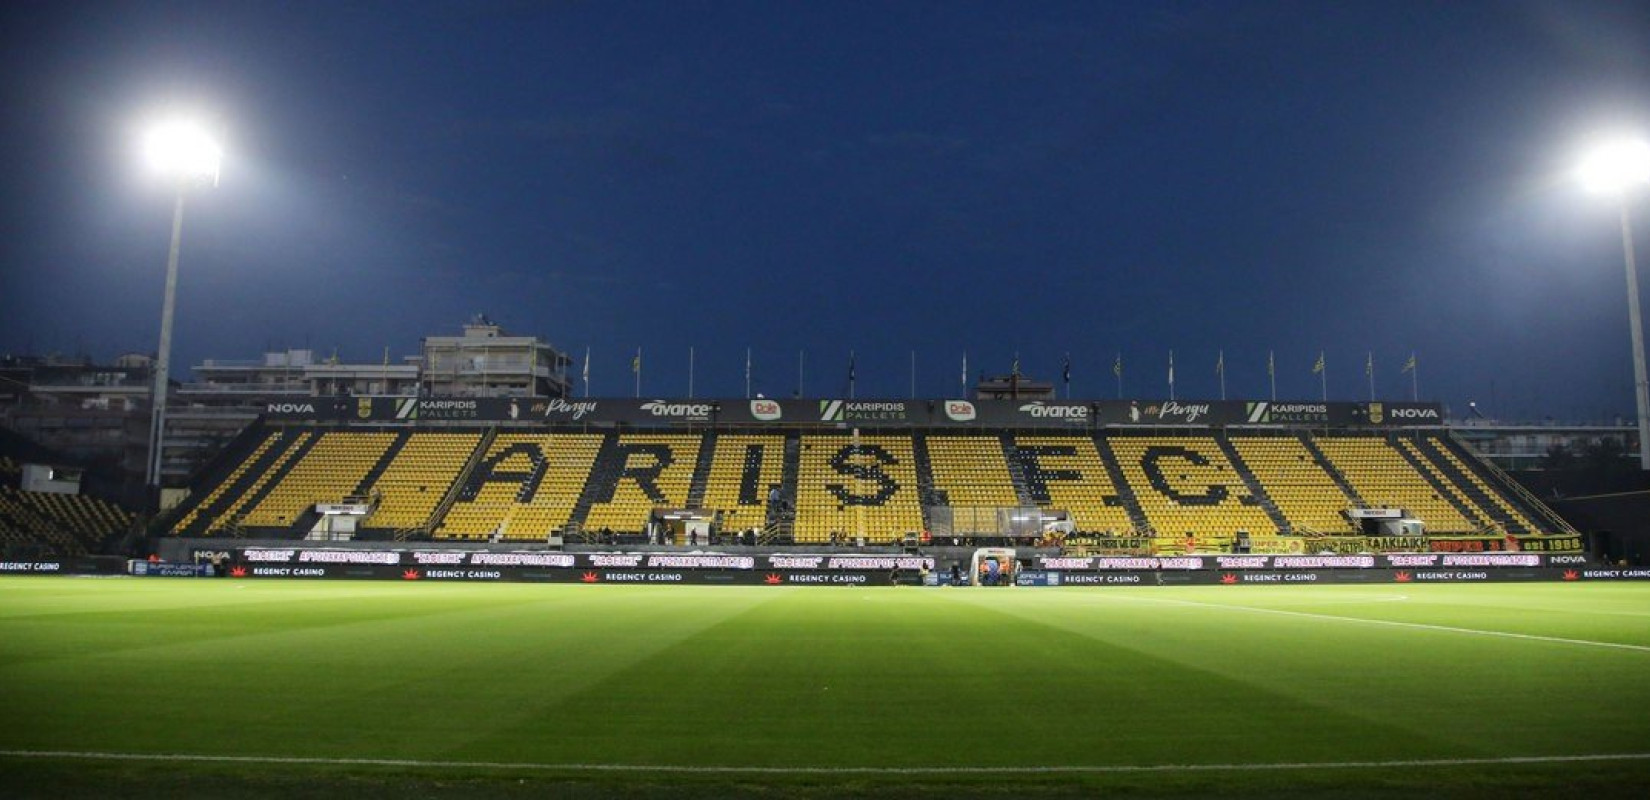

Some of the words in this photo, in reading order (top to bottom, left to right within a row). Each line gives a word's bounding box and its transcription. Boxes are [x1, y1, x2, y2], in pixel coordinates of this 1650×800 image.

[267, 403, 315, 413] NOVA
[419, 401, 477, 410] KARIPIDIS
[651, 403, 709, 416] avance
[845, 402, 905, 412] KARIPIDIS
[1271, 404, 1327, 413] KARIPIDIS
[419, 410, 478, 418] PALLETS
[1030, 405, 1088, 418] avance
[1391, 408, 1438, 418] NOVA
[1271, 413, 1328, 421] PALLETS
[1550, 556, 1587, 564] NOVA
[0, 562, 33, 570] REGENCY
[34, 562, 60, 571] CASINO
[253, 568, 290, 576] REGENCY
[293, 568, 325, 577] CASINO
[426, 570, 465, 578] REGENCY
[467, 571, 501, 579] CASINO
[605, 573, 645, 581] REGENCY
[648, 573, 682, 581] CASINO
[1416, 572, 1454, 580] REGENCY
[1456, 572, 1487, 580] CASINO
[1583, 570, 1620, 578] REGENCY
[832, 575, 867, 583] CASINO
[1064, 575, 1104, 583] REGENCY
[1106, 575, 1141, 583] CASINO
[1243, 574, 1281, 582] REGENCY
[1284, 574, 1317, 582] CASINO
